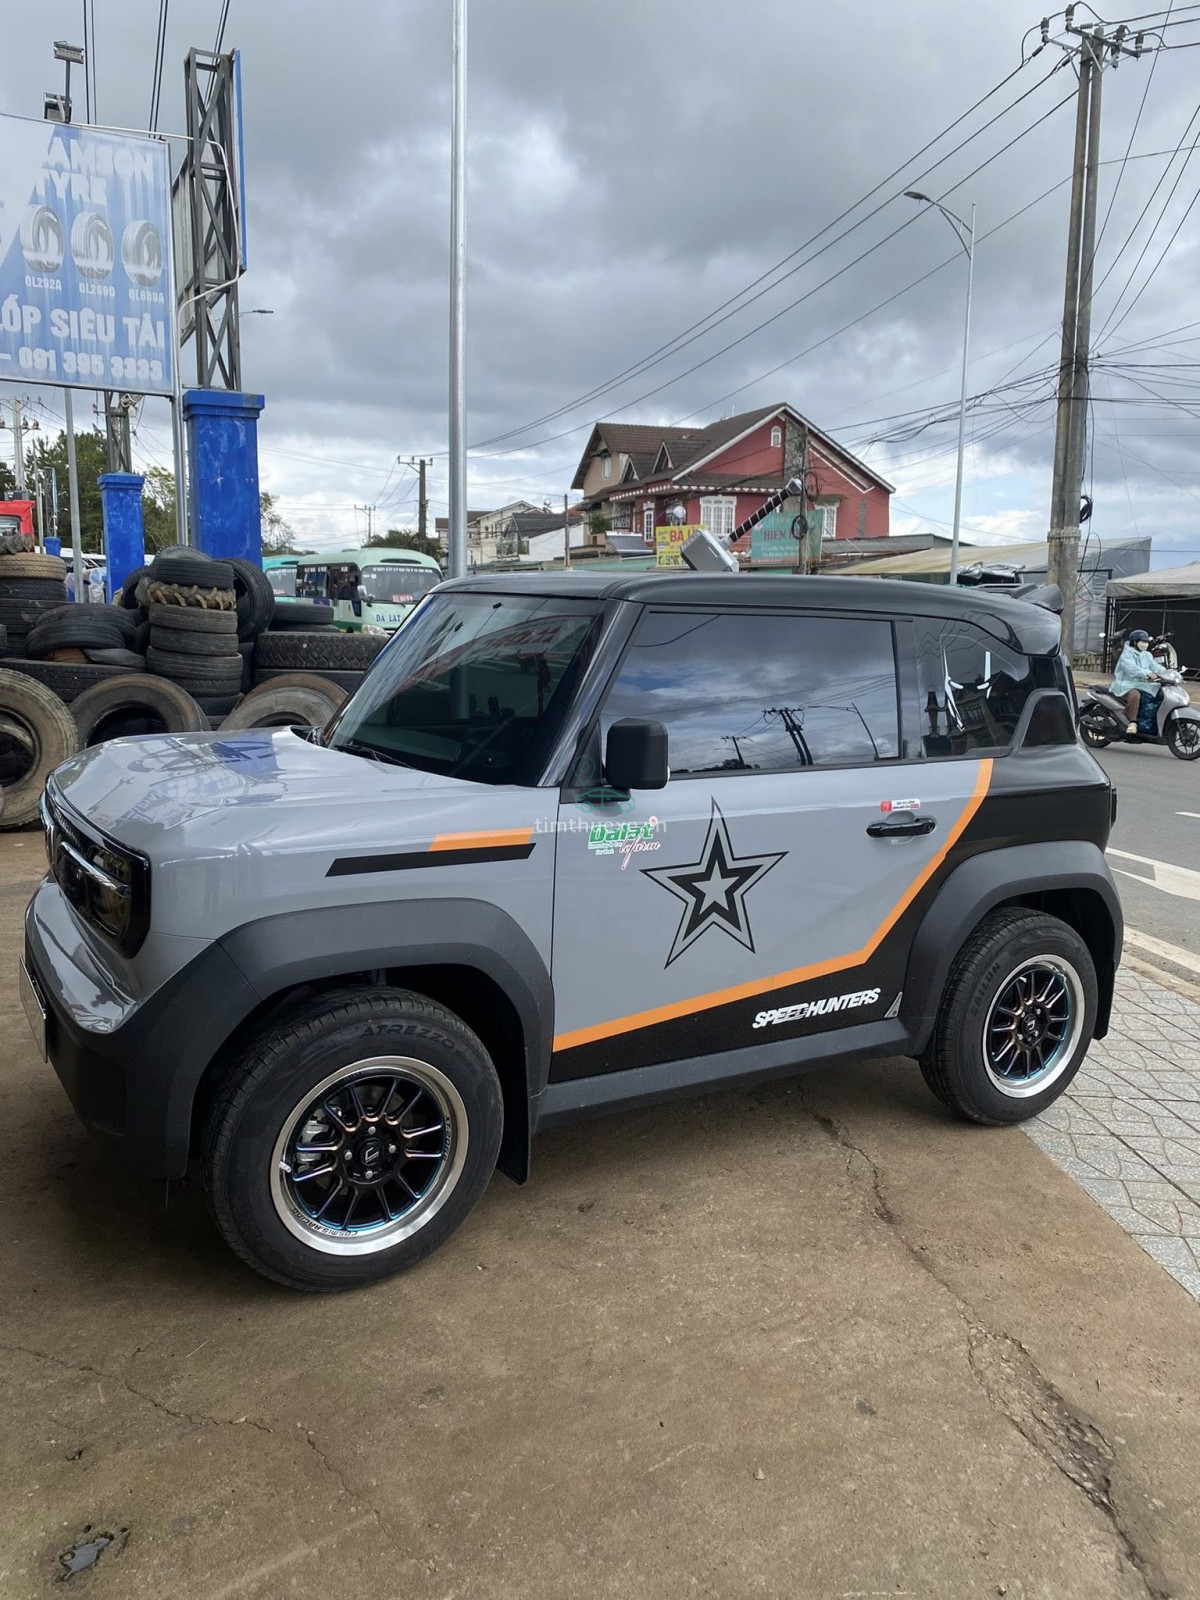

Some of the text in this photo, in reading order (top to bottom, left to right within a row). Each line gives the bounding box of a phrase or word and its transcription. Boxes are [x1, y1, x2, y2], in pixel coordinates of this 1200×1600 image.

[50, 306, 115, 343] SIÊU
[18, 346, 163, 381] 091 395 3333
[752, 987, 881, 1029] SPEEDHUNTERS
[359, 1023, 455, 1050] ATREZZO
